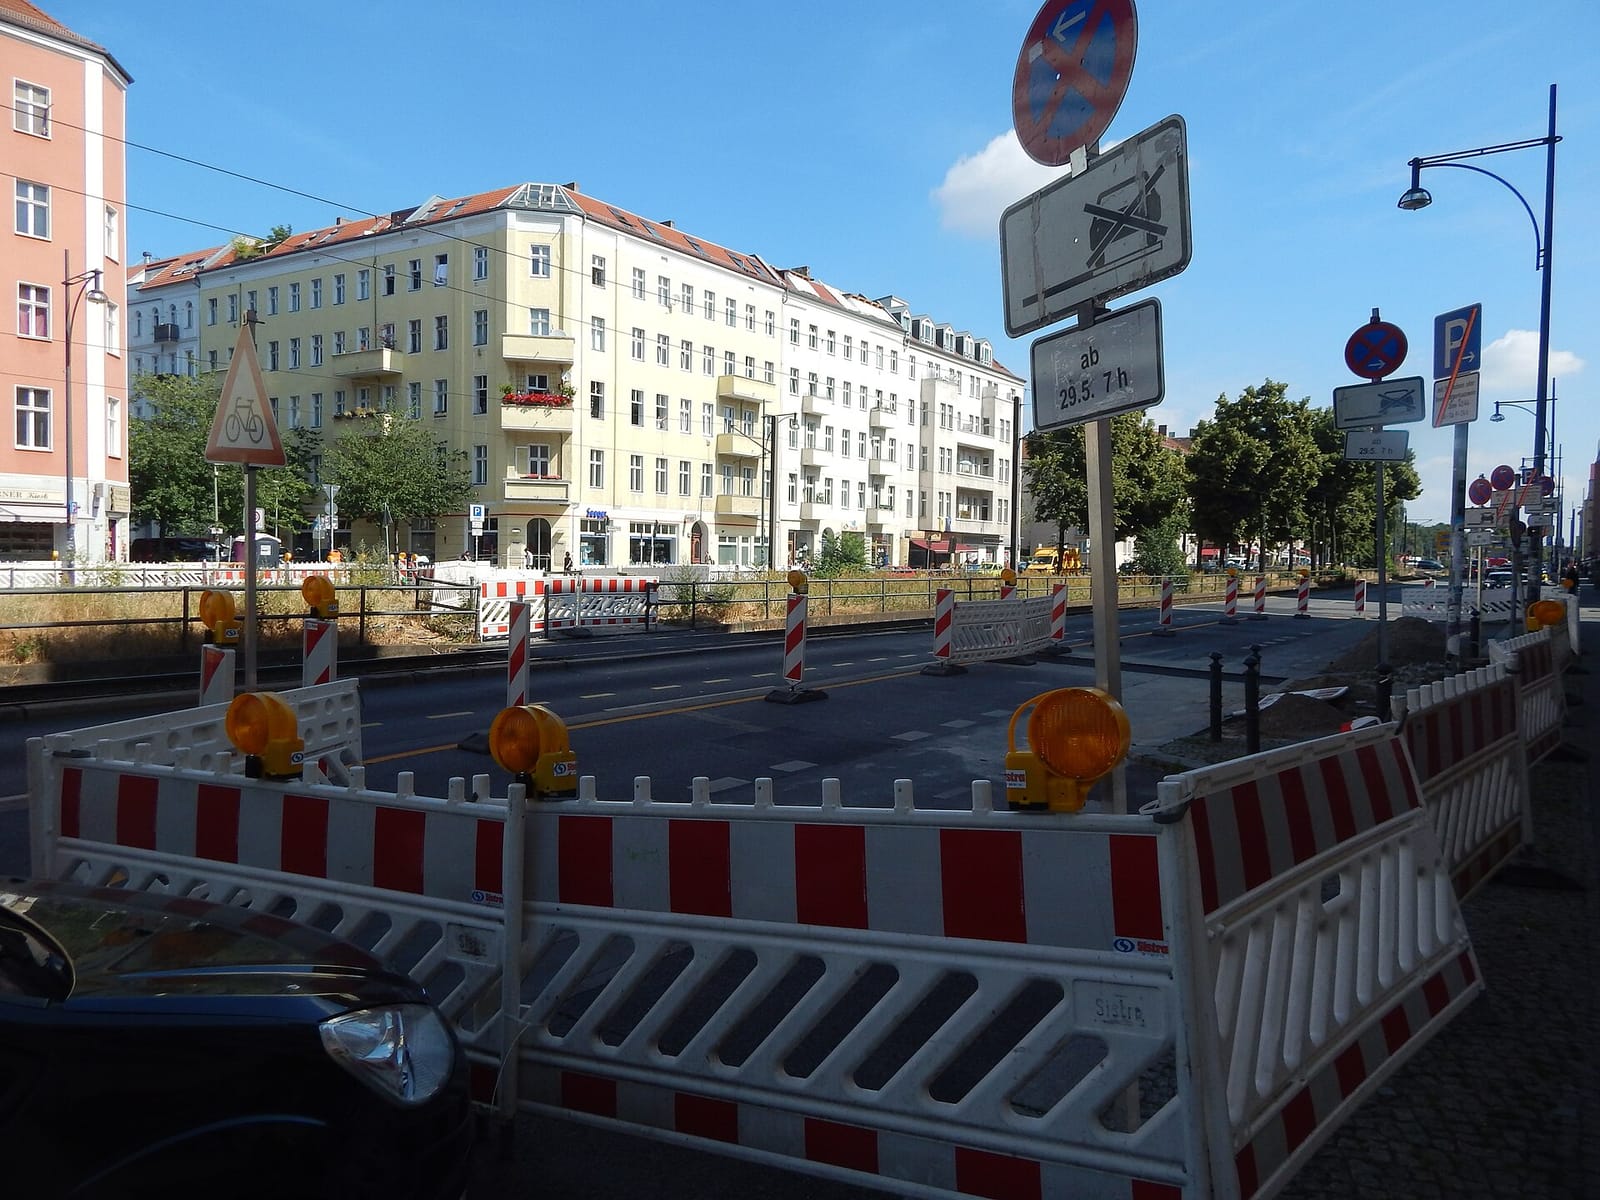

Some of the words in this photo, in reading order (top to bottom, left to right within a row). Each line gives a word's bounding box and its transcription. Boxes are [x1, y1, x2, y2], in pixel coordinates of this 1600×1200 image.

[1080, 345, 1100, 370] ab
[1444, 318, 1468, 369] P
[1059, 379, 1095, 410] 29.5.
[1103, 370, 1112, 393] 7
[1117, 366, 1128, 389] h
[1137, 941, 1169, 954] Sistra
